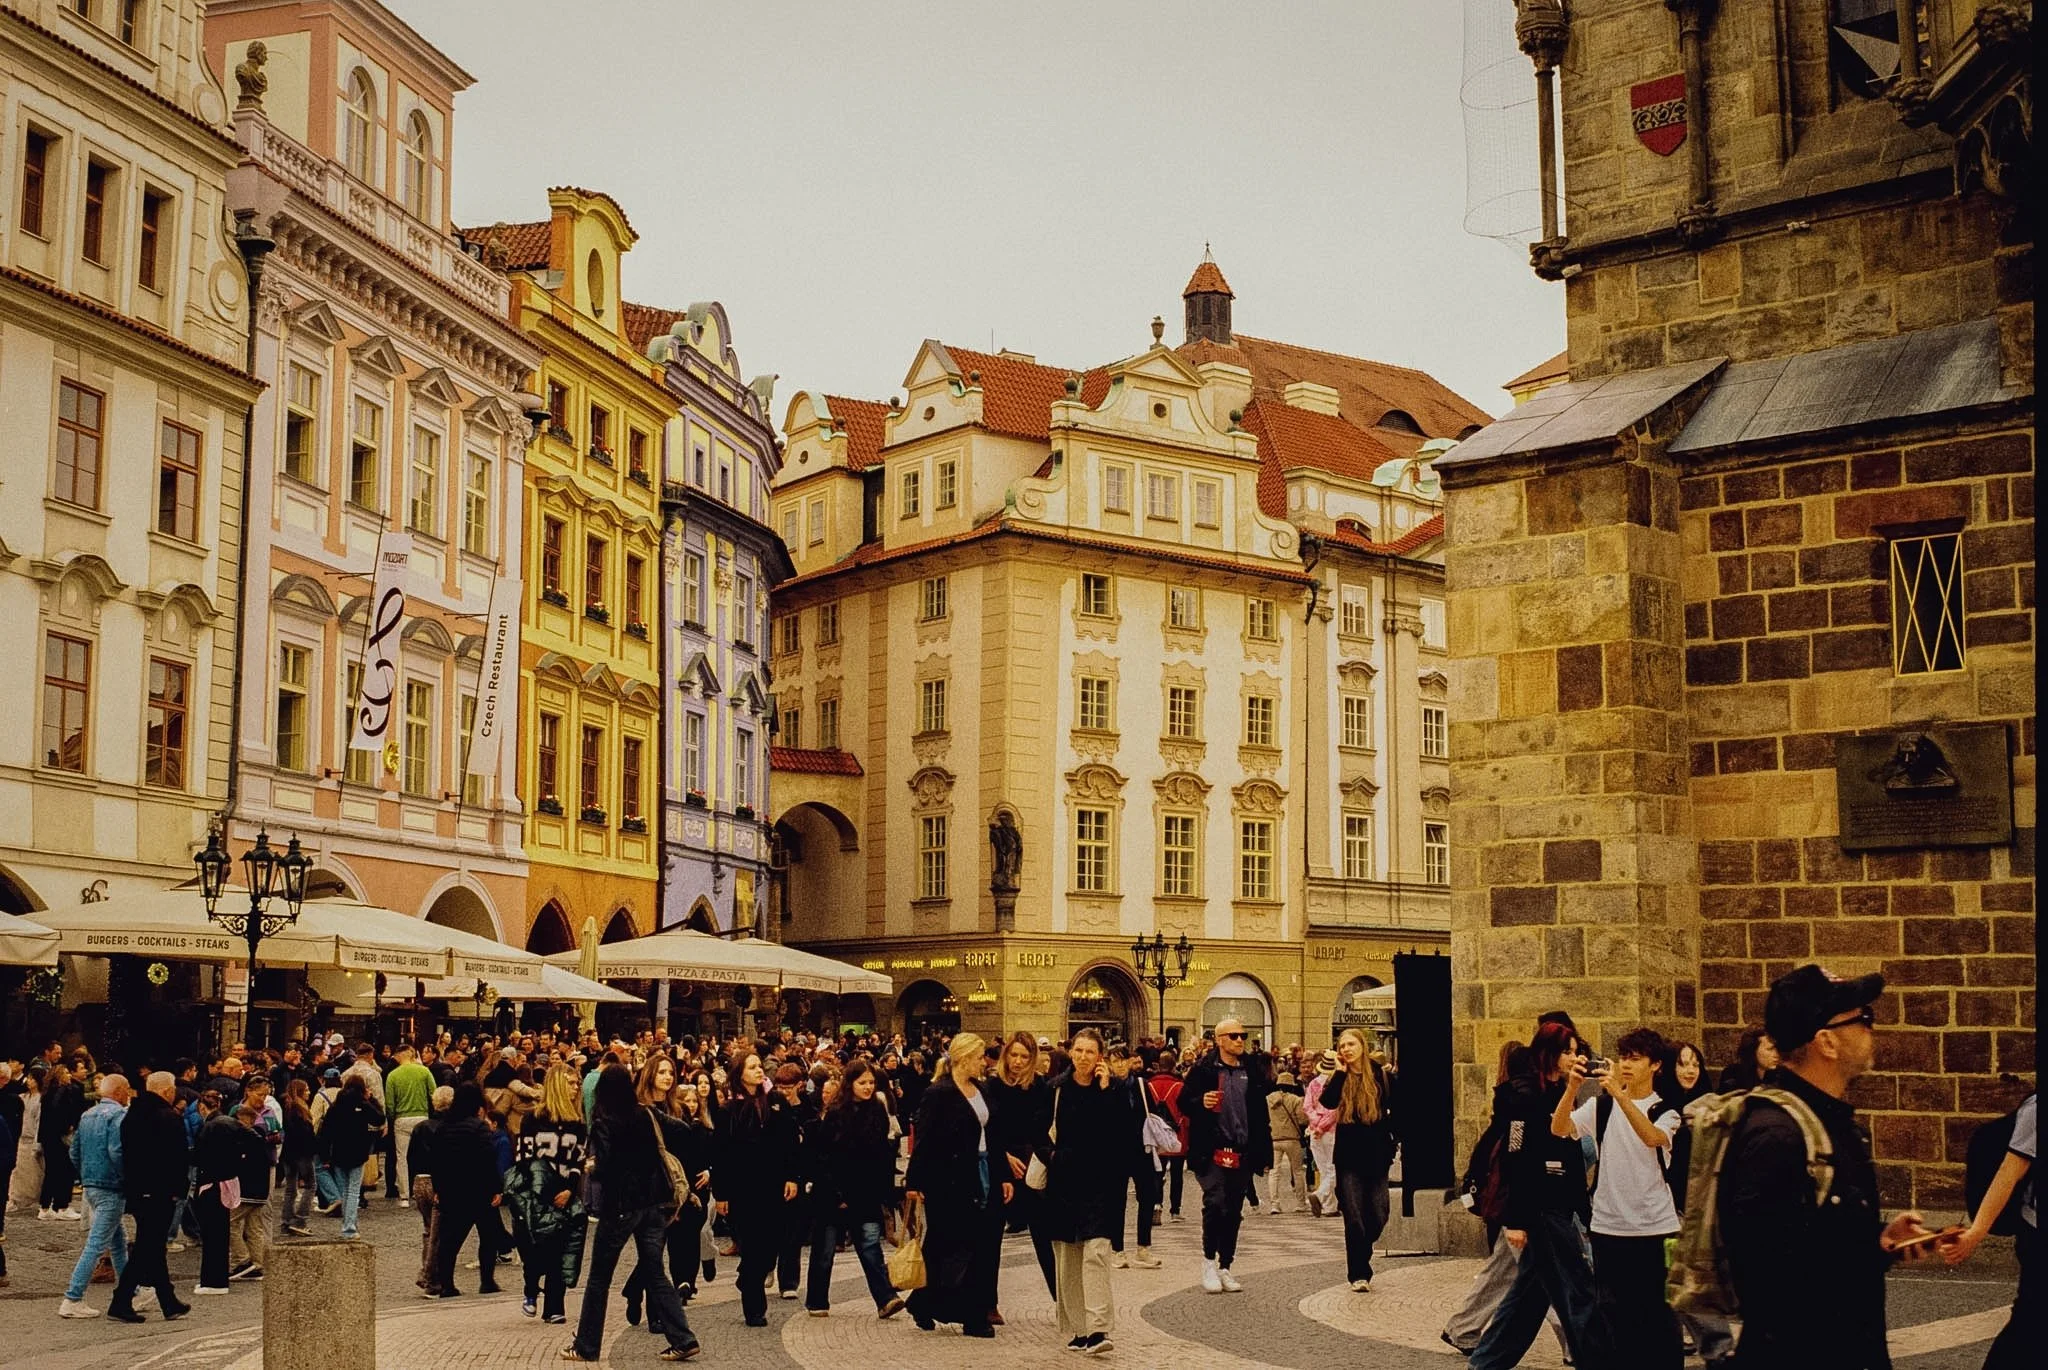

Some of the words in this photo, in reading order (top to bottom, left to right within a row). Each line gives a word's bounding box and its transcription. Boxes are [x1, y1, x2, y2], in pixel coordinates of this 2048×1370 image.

[383, 551, 408, 564] MOZART
[488, 614, 508, 690] Restaurant
[481, 695, 496, 737] Czech
[87, 935, 128, 945] BURGERS
[138, 936, 186, 947] COCKTAILS
[196, 939, 229, 949] STEAKS
[354, 951, 377, 963] BURGERS
[411, 957, 429, 967] STEAKS
[964, 952, 997, 967] ERPET
[1018, 952, 1057, 967] ERPET
[606, 967, 639, 977] PASTA
[668, 967, 698, 978] PIZZA
[701, 970, 709, 979] &
[713, 971, 746, 982] PASTA
[1340, 1013, 1378, 1023] L'OROLOGIO
